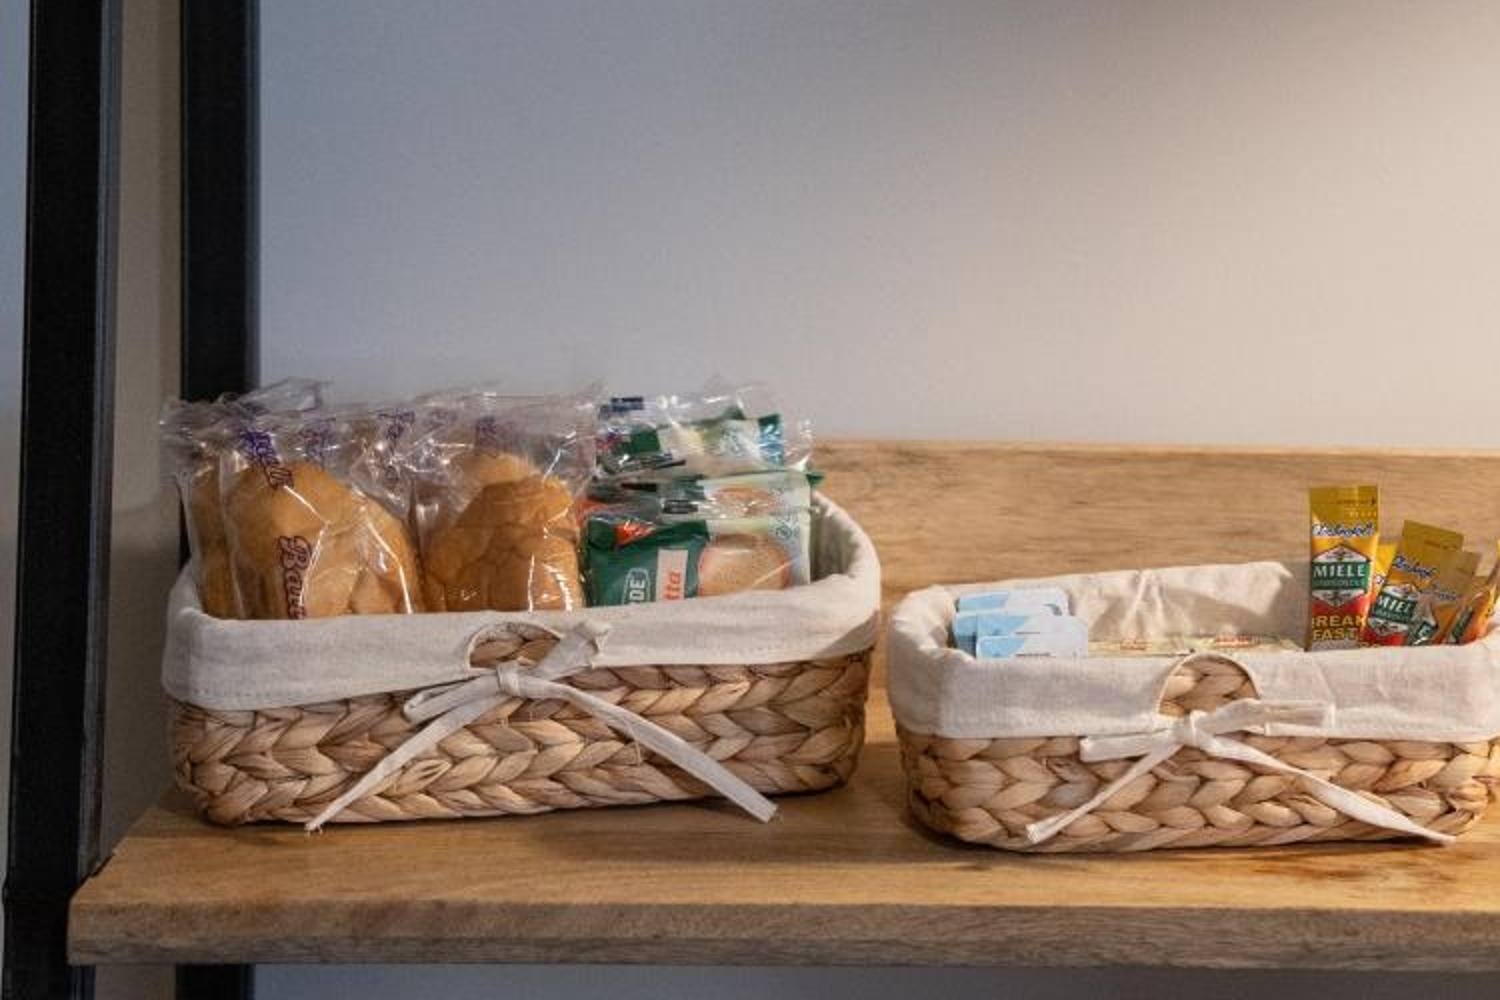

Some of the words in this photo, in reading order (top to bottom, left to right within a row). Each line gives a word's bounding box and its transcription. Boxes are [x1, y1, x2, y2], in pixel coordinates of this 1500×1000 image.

[1313, 564, 1365, 578] MIELE
[1311, 615, 1367, 627] REAK
[1313, 628, 1358, 641] FAST
